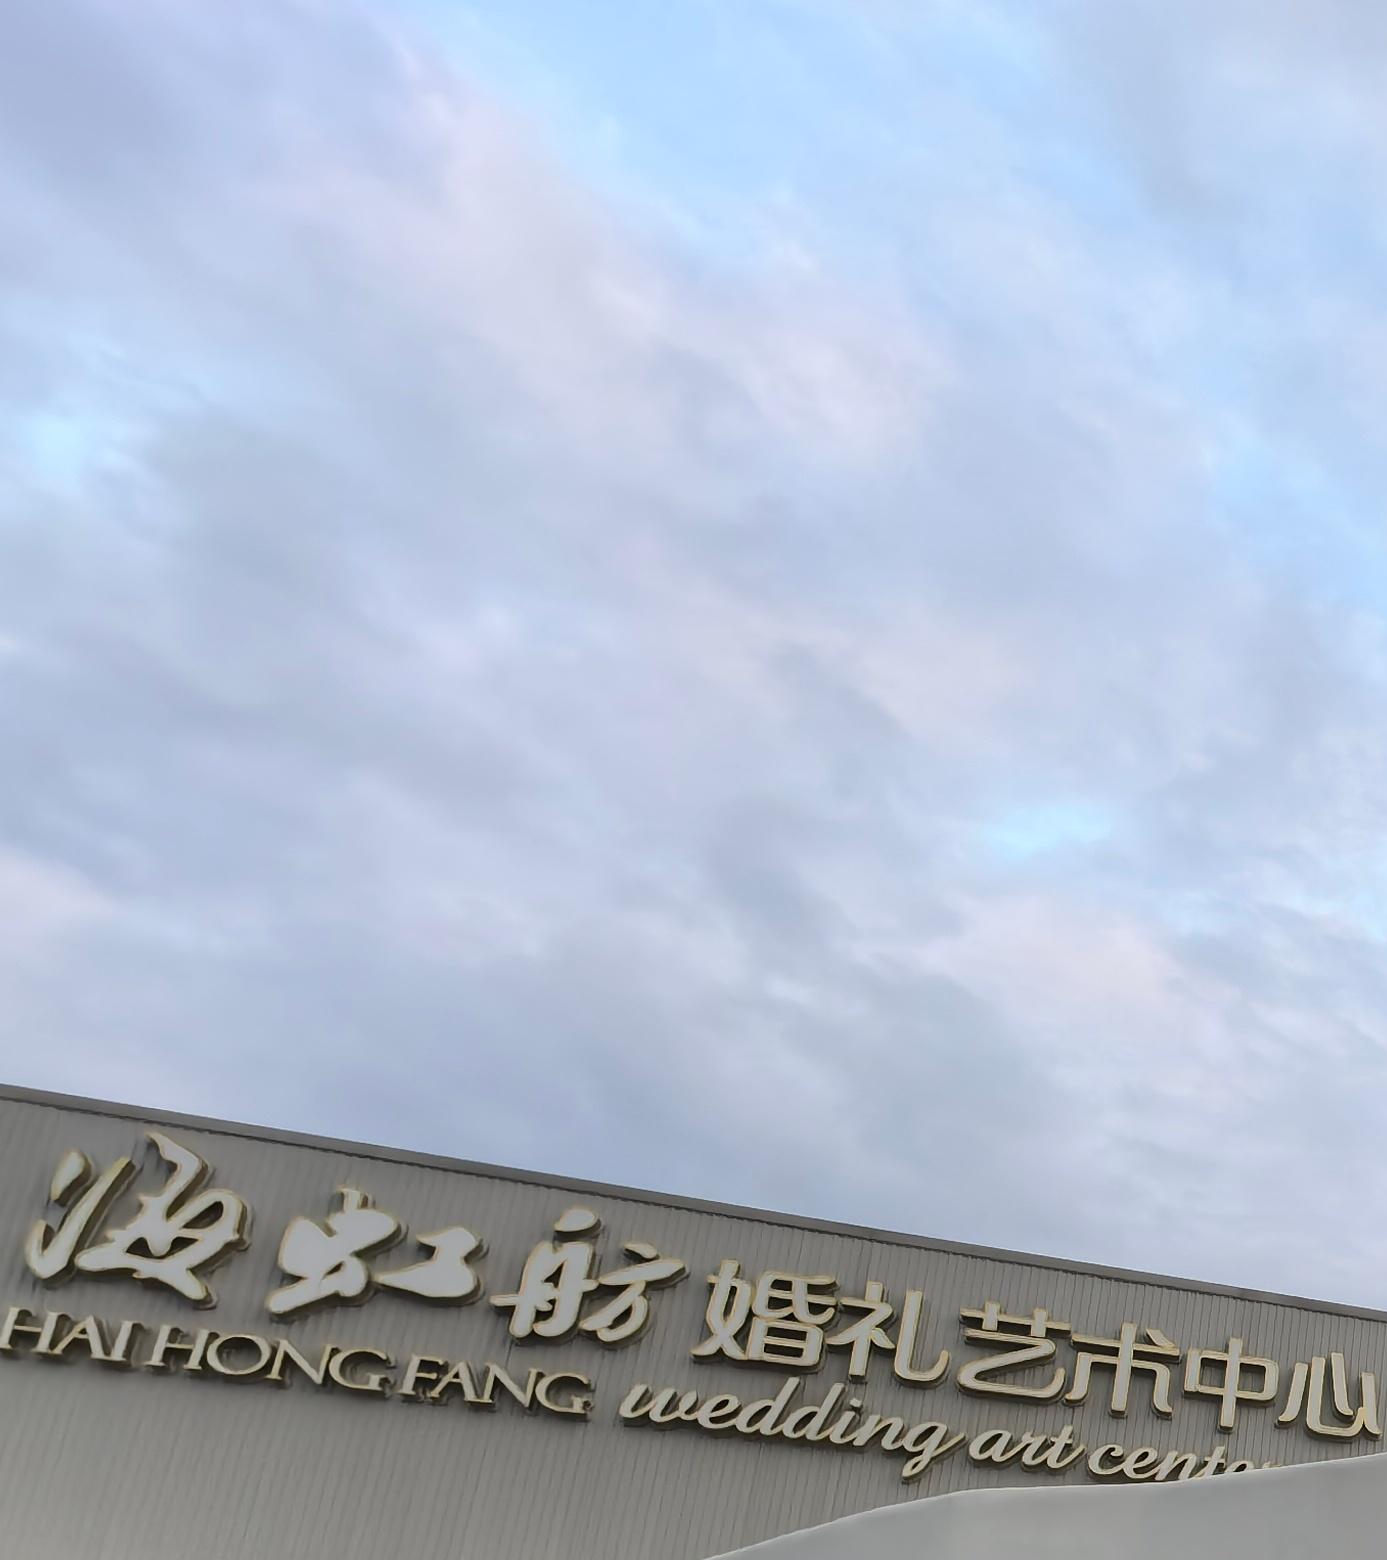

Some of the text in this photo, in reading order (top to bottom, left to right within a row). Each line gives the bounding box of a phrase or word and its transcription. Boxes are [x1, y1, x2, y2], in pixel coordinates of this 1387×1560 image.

[0, 1306, 128, 1362] HAI
[147, 1324, 396, 1392] HONG
[400, 1354, 591, 1415] FANG
[618, 1376, 968, 1481] wedding
[968, 1424, 1087, 1470] art
[691, 1259, 1382, 1440] 婚礼艺术中心
